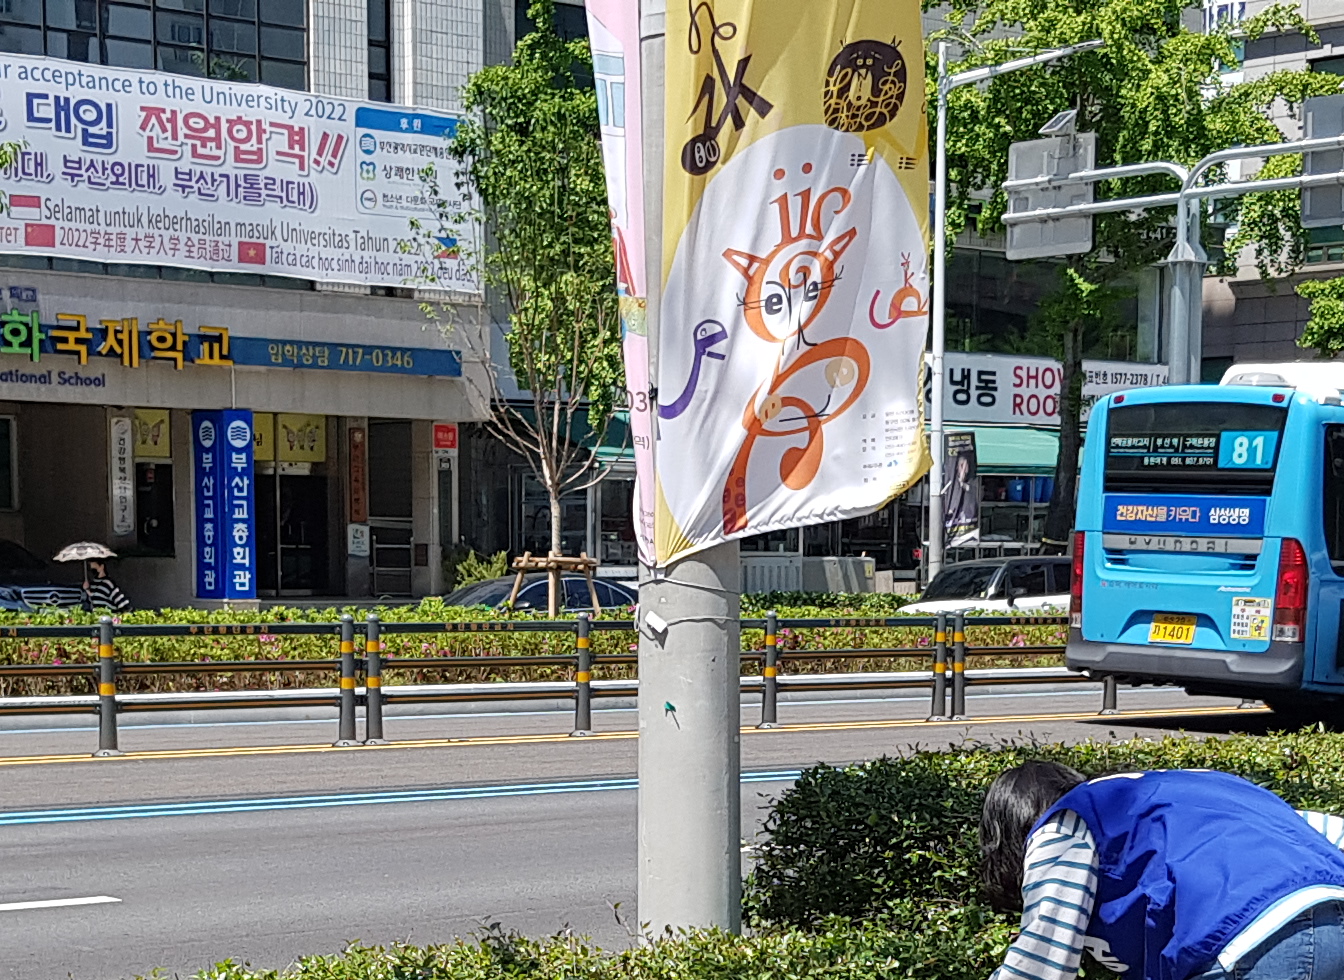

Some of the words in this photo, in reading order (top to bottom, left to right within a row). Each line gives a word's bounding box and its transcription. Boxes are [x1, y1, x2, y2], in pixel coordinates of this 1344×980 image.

[18, 64, 132, 94] acceptance
[138, 76, 157, 96] to
[163, 79, 195, 102] the
[202, 85, 298, 120] University
[303, 98, 347, 122] 2022
[26, 91, 114, 150] 대입
[138, 104, 344, 172] 전원합격!!
[62, 154, 164, 192] 부산외대,
[173, 167, 318, 212] 부산가톨릭대)
[44, 197, 101, 227] Selamat
[104, 204, 144, 229] untuk
[147, 210, 231, 238] keberhasilan
[235, 218, 278, 242] masuk
[281, 220, 349, 251] Universitas
[353, 230, 390, 254] Tahun
[393, 238, 422, 257] 2022
[59, 226, 128, 254] 2022学年度
[131, 234, 181, 258] 大学入学
[184, 236, 233, 263] 全员通过
[299, 248, 316, 270] các
[318, 252, 336, 277] học
[374, 258, 391, 281] học
[267, 343, 329, 367] 입학상담
[338, 347, 414, 369] 717-0346
[57, 372, 106, 388] School
[949, 367, 998, 408] 냉동
[1082, 370, 1109, 386] 표번호
[1110, 371, 1149, 386] 1577-2378
[1012, 393, 1058, 417] ROO
[1232, 435, 1265, 465] 81
[201, 452, 216, 591] 부산교총회관
[231, 452, 252, 591] 부산교총회관
[1115, 505, 1168, 522] 건강자산을
[1168, 506, 1201, 523] 키우다
[1208, 507, 1250, 525] 삼성생명
